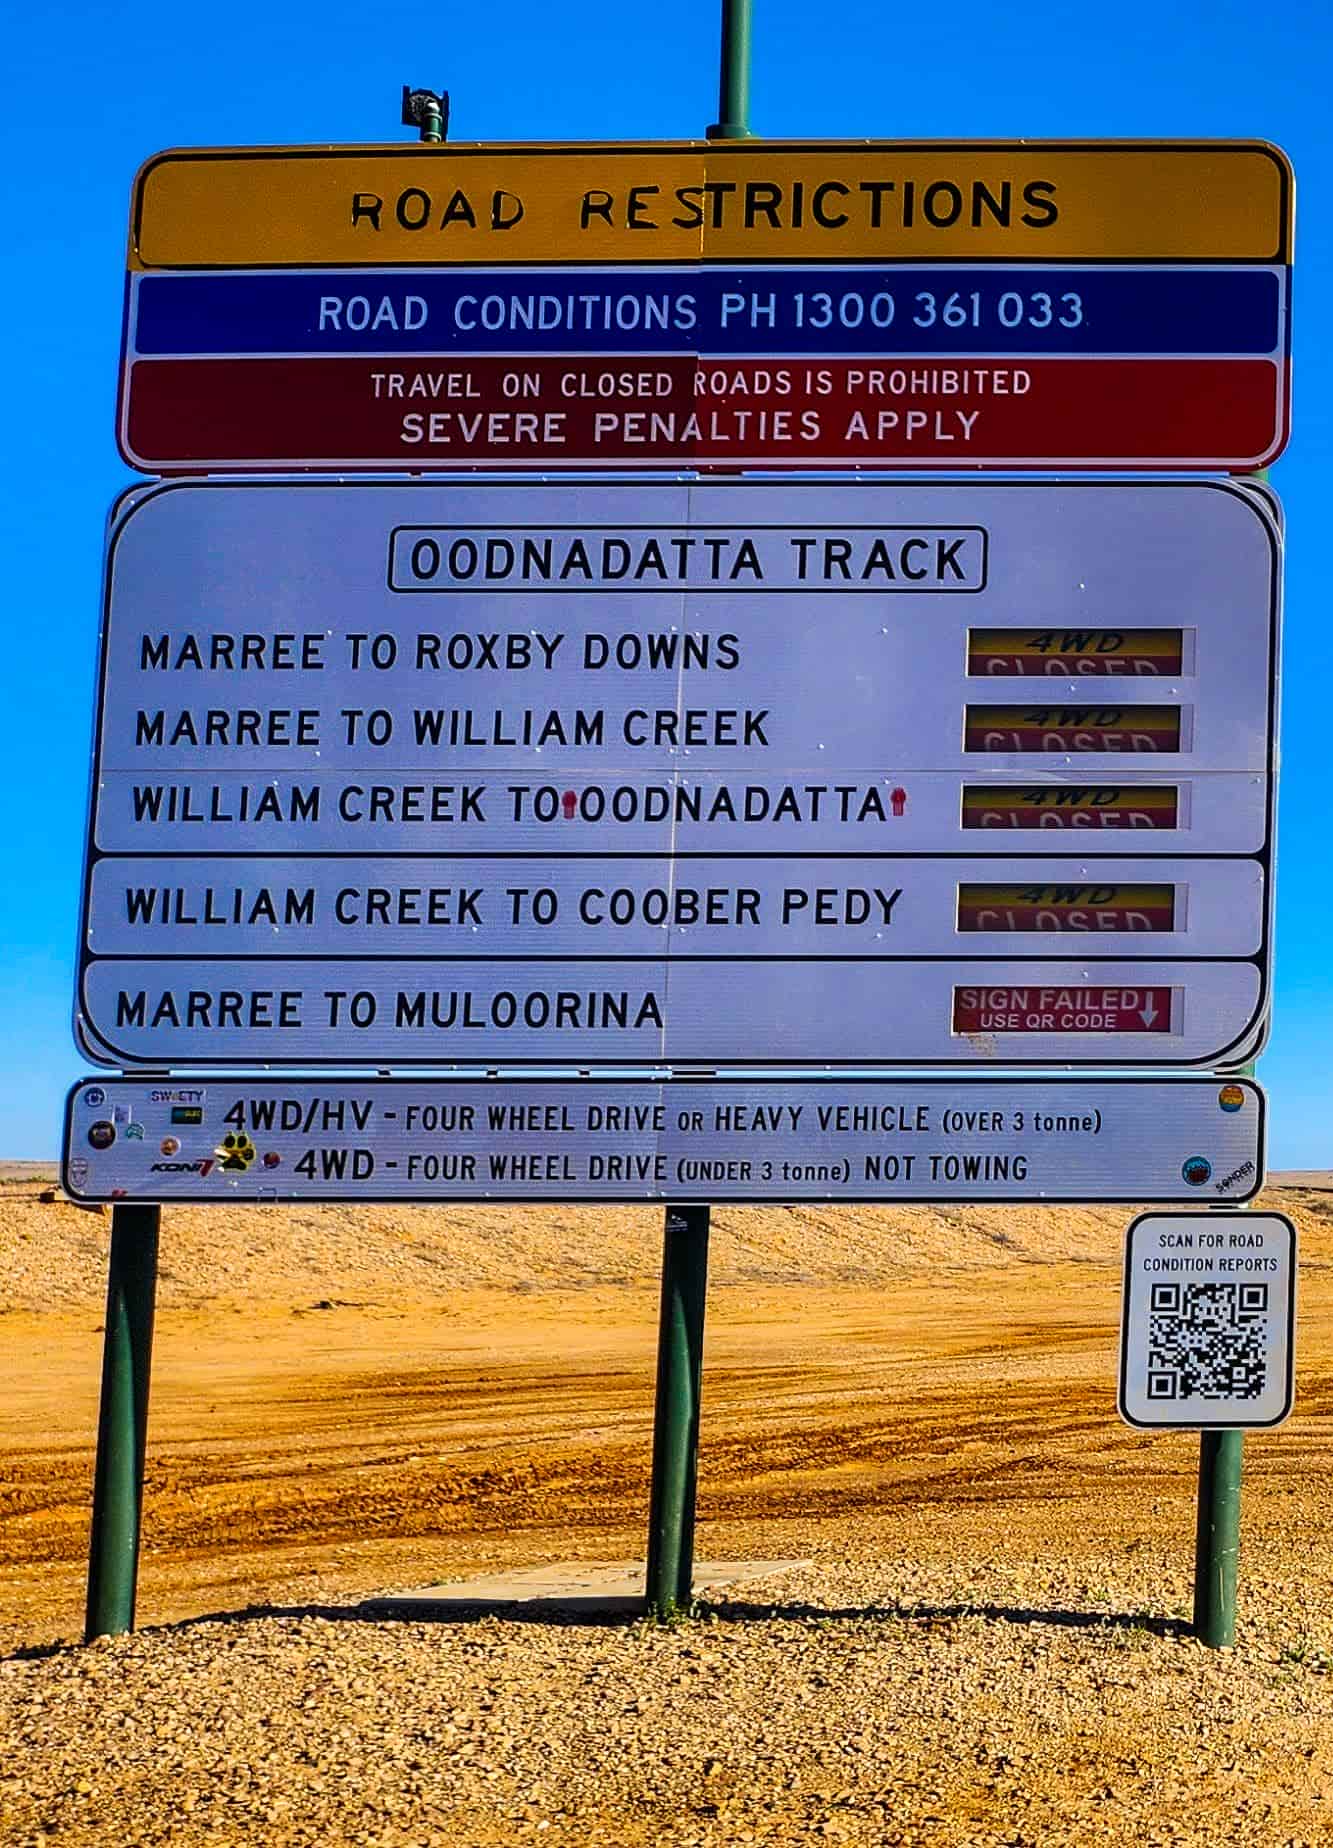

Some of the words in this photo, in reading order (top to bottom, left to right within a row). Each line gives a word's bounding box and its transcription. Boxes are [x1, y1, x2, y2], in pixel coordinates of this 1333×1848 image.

[351, 188, 524, 231] ROAD
[580, 181, 1059, 230] RESTRICTIONS
[318, 296, 427, 330] ROAD
[454, 295, 697, 330] CONDITIONS
[720, 293, 776, 328] PH
[794, 293, 895, 328] 1300
[913, 293, 980, 328] 361
[998, 293, 1084, 328] 033
[371, 374, 480, 398] TRAVEL
[503, 373, 540, 397] ON
[561, 373, 673, 397] CLOSED
[694, 371, 791, 396] ROADS
[805, 371, 833, 395] IS
[846, 371, 1031, 395] PROHIBITED
[400, 413, 566, 444] SEVERE
[594, 411, 821, 443] PENALTIES
[845, 411, 981, 441] APPLY
[411, 539, 763, 580] OODNADATTA
[791, 538, 967, 580] TRACK
[140, 635, 325, 670] MARREE
[346, 635, 397, 670] TO
[416, 635, 564, 670] ROXBY
[583, 634, 740, 670] DOWNS
[1026, 631, 1125, 653] 4WD
[135, 711, 320, 746] MARREE
[341, 711, 392, 746] TO
[414, 711, 603, 746] WILLIAM
[623, 711, 769, 746] CREEK
[1024, 710, 1124, 727] 4WD
[132, 786, 320, 822] WILLIAM
[339, 786, 486, 822] CREEK
[508, 786, 560, 822] TO
[580, 786, 887, 822] OODNADATTA
[1021, 790, 1120, 806] 4WD
[126, 888, 315, 925] WILLIAM
[335, 888, 483, 925] CREEK
[507, 888, 558, 925] TO
[579, 888, 761, 925] COOBER
[783, 888, 903, 924] PEDY
[1017, 887, 1118, 904] 4WD
[115, 991, 303, 1028] MARREE
[324, 991, 376, 1028] TO
[395, 991, 663, 1028] MULOORINA
[960, 989, 1028, 1010] SIGN
[1039, 989, 1138, 1010] FAILED
[980, 1013, 1019, 1028] USE
[1026, 1013, 1055, 1028] QR
[1061, 1013, 1116, 1028] CODE
[224, 1097, 373, 1132] 4WD/HV
[406, 1105, 475, 1132] FOUR
[488, 1105, 575, 1132] WHEEL
[587, 1105, 665, 1132] DRIVE
[678, 1112, 704, 1131] OR
[715, 1106, 802, 1131] HEAVY
[818, 1106, 930, 1131] VEHICLE
[943, 1109, 1003, 1134] (OVER
[1013, 1112, 1024, 1131] 3
[1033, 1109, 1102, 1134] tonne)
[294, 1151, 375, 1180] 4WD
[407, 1156, 475, 1181] FOUR
[489, 1155, 577, 1181] WHEEL
[590, 1155, 667, 1180] DRIVE
[677, 1159, 752, 1183] (UNDER
[761, 1162, 772, 1181] 3
[782, 1159, 850, 1183] tonne)
[865, 1156, 918, 1181] NOT
[929, 1155, 1028, 1181] TOWING
[1159, 1234, 1193, 1247] SCAN
[1198, 1234, 1224, 1247] FOR
[1229, 1234, 1264, 1247] ROAD
[1143, 1258, 1213, 1271] CONDITION
[1219, 1258, 1277, 1271] REPORTS
